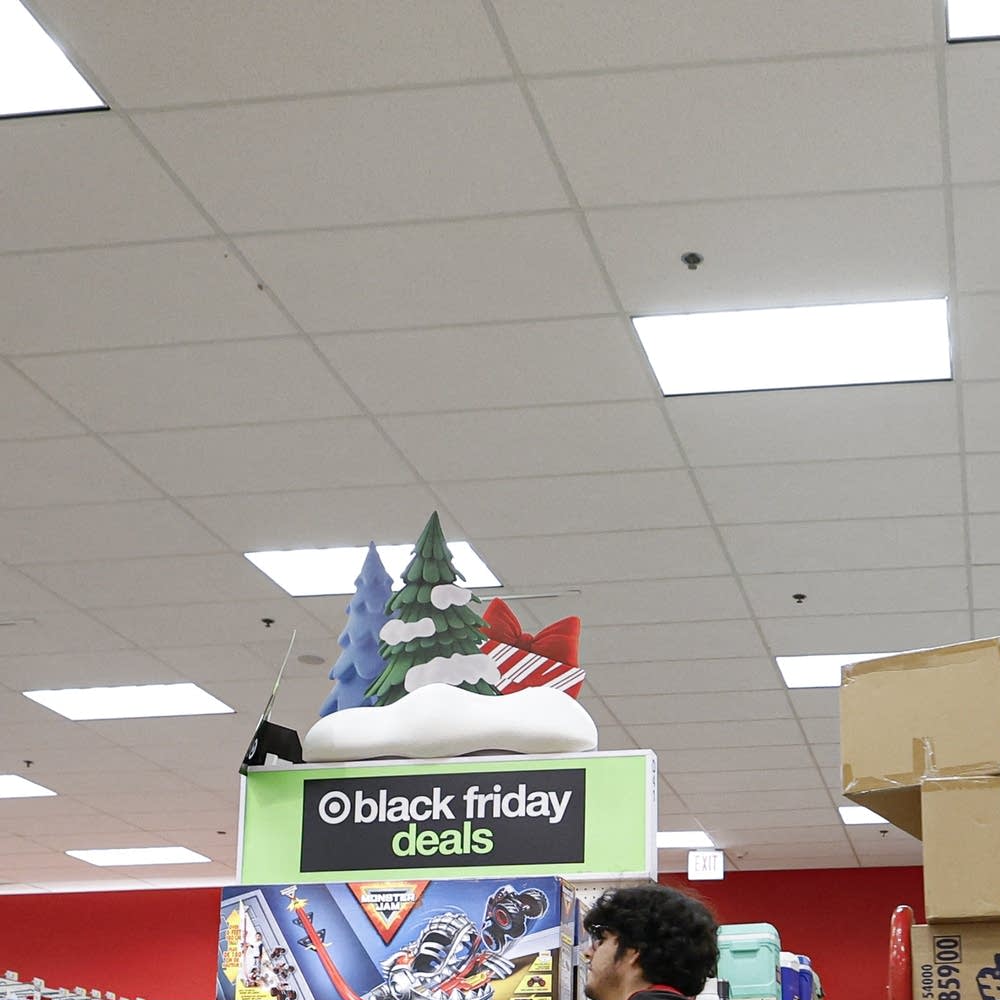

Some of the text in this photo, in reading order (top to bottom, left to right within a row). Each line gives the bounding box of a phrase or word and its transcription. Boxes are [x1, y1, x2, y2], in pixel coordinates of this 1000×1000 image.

[353, 784, 572, 824] black friday
[391, 821, 494, 856] deals
[695, 855, 718, 872] EXIT
[361, 893, 415, 902] MONSTER
[376, 902, 400, 911] JAM
[936, 939, 959, 961] 00
[921, 964, 934, 998] 54000
